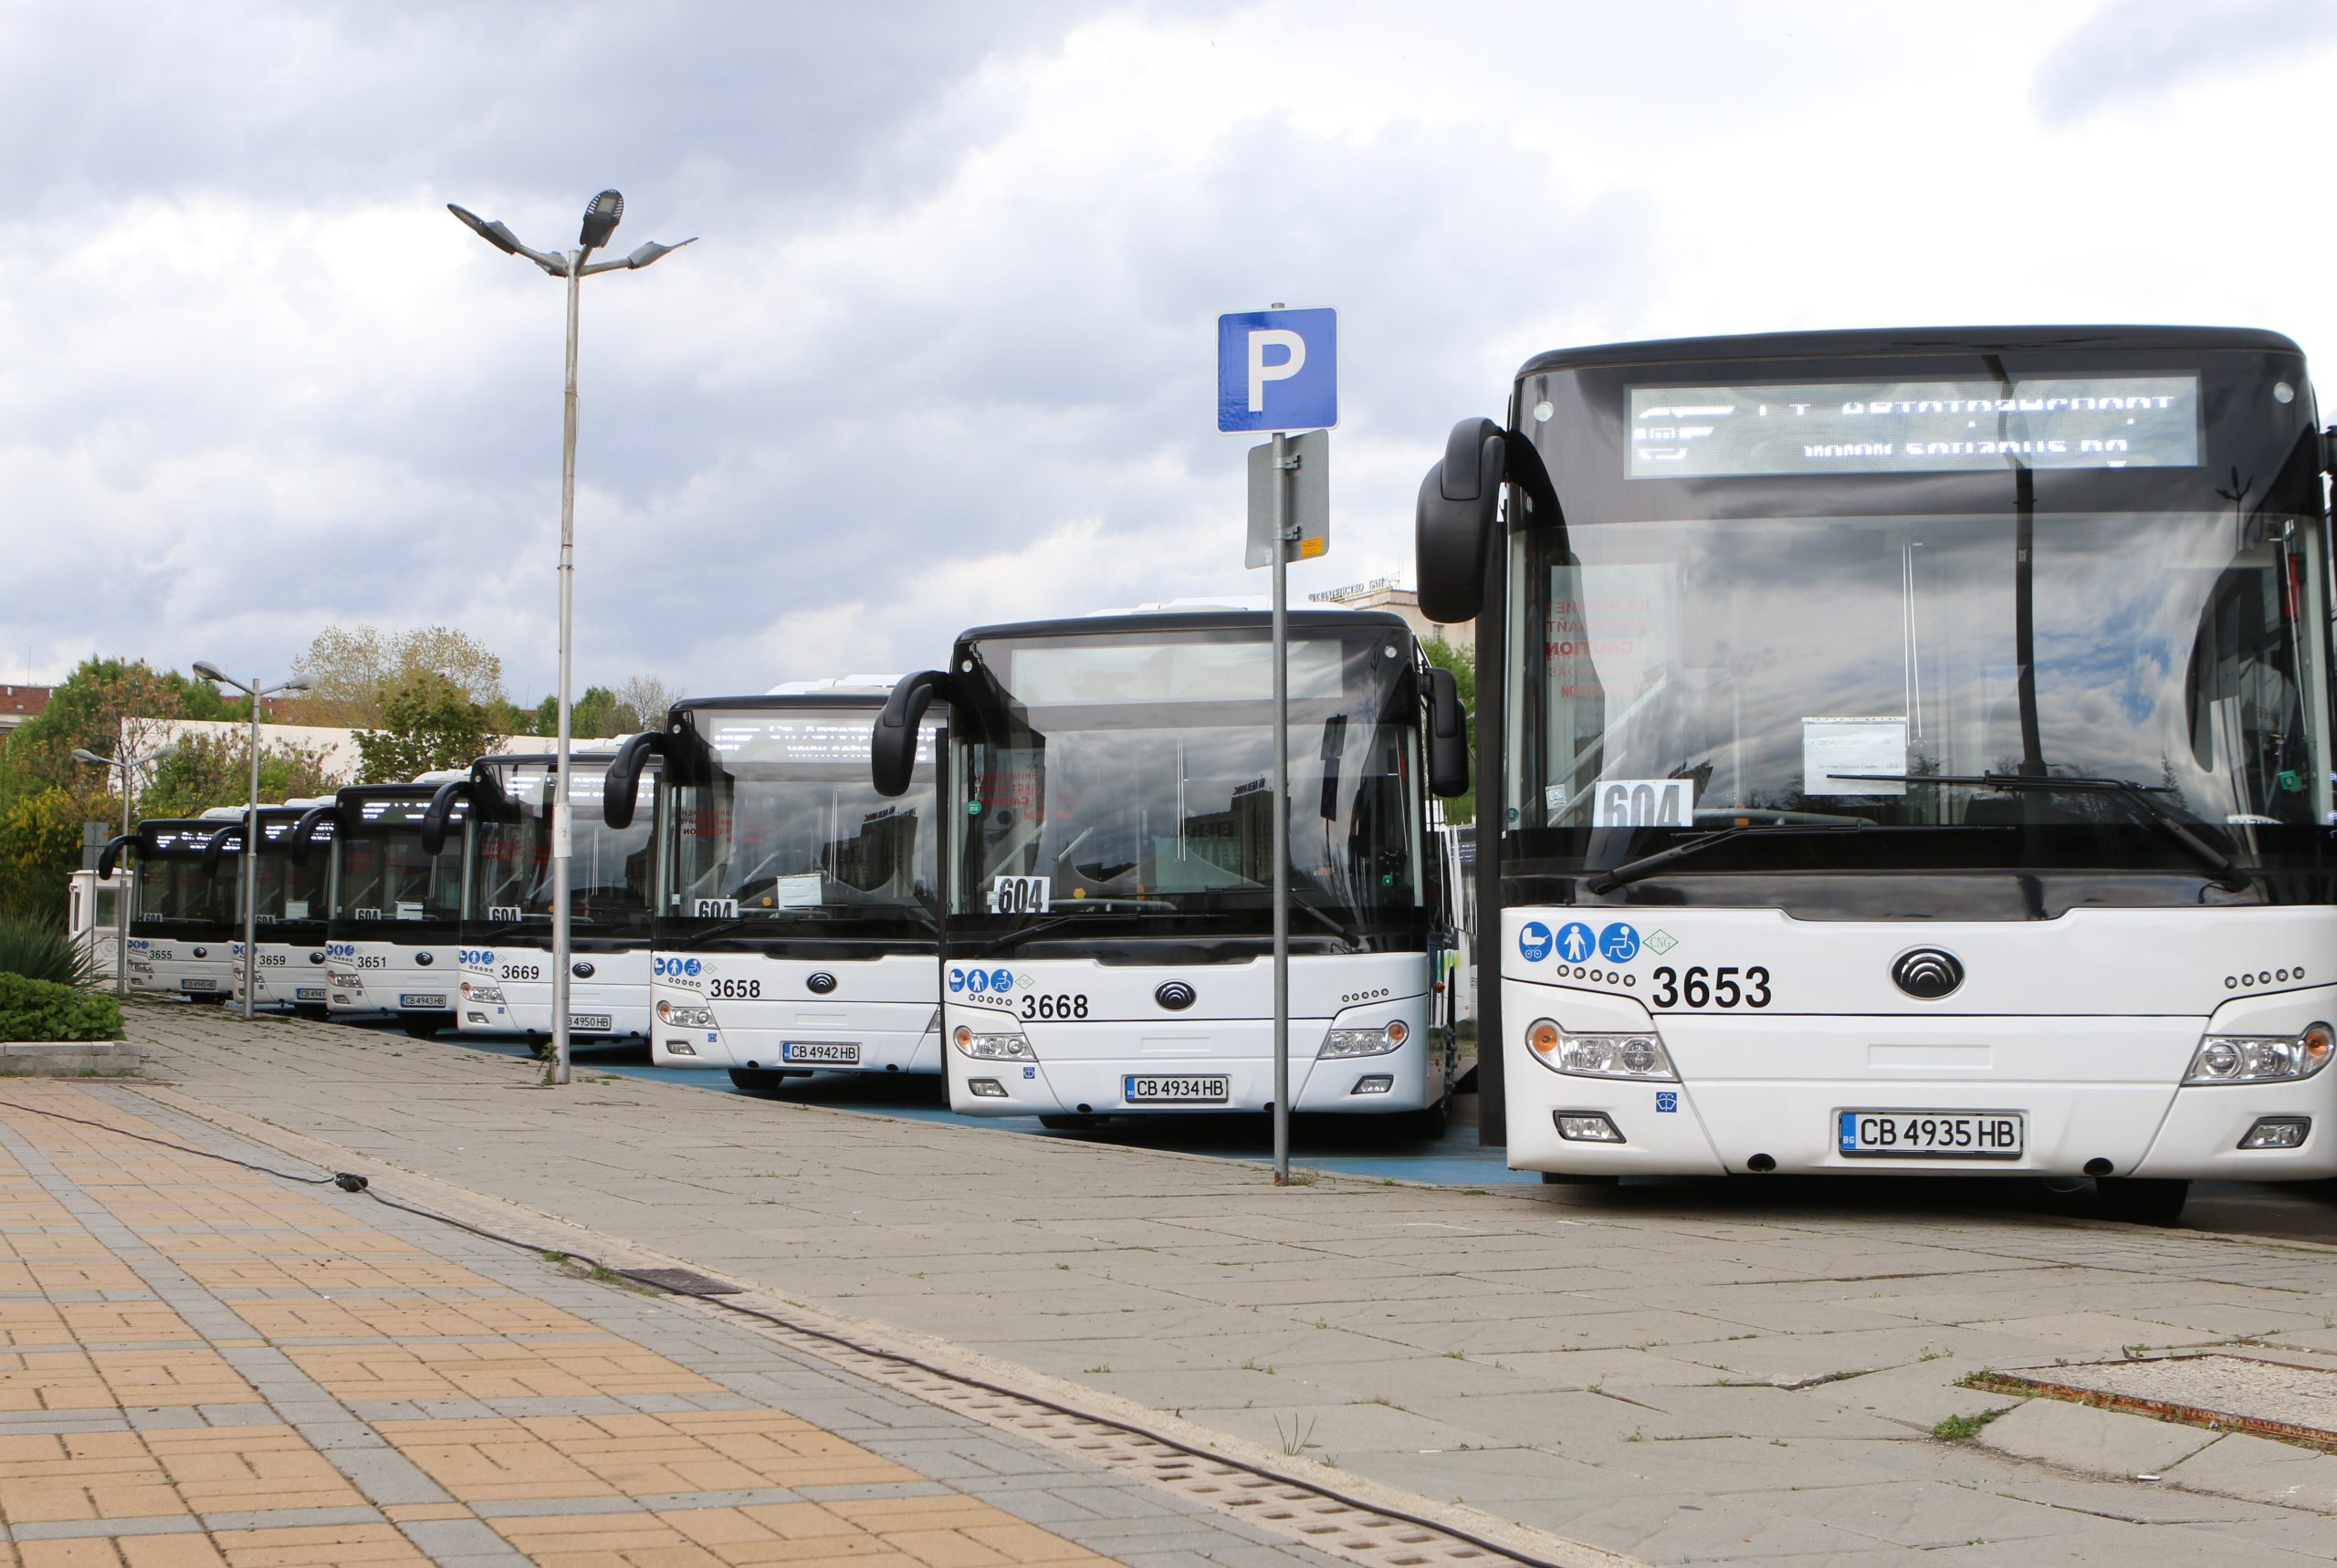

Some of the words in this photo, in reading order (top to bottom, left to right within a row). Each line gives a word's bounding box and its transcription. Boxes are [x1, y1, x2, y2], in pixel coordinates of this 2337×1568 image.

[1248, 329, 1305, 412] P
[1603, 784, 1682, 826] 604
[999, 878, 1043, 913] 604
[698, 900, 732, 917] 604
[1650, 936, 1671, 948] CNG
[149, 949, 173, 959] 3655
[259, 955, 286, 965] 3659
[357, 956, 386, 968] 3651
[501, 965, 540, 979] 3669
[710, 978, 760, 998] 3658
[1651, 966, 1771, 1009] 3653
[405, 997, 415, 1005] CB
[416, 997, 433, 1005] 4943
[434, 997, 444, 1005] HB
[1022, 994, 1088, 1019] 3668
[573, 1017, 595, 1027] 4950
[596, 1018, 609, 1027] HB
[791, 1045, 807, 1058] CB
[810, 1046, 838, 1059] 4942
[840, 1047, 856, 1059] HB
[1137, 1080, 1158, 1096] CB
[1161, 1080, 1200, 1096] 4934
[1202, 1080, 1223, 1096] HB
[1842, 1135, 1855, 1144] BG
[1860, 1119, 1897, 1145] CB
[1903, 1119, 1972, 1146] 4935
[1978, 1120, 2015, 1147] HB
